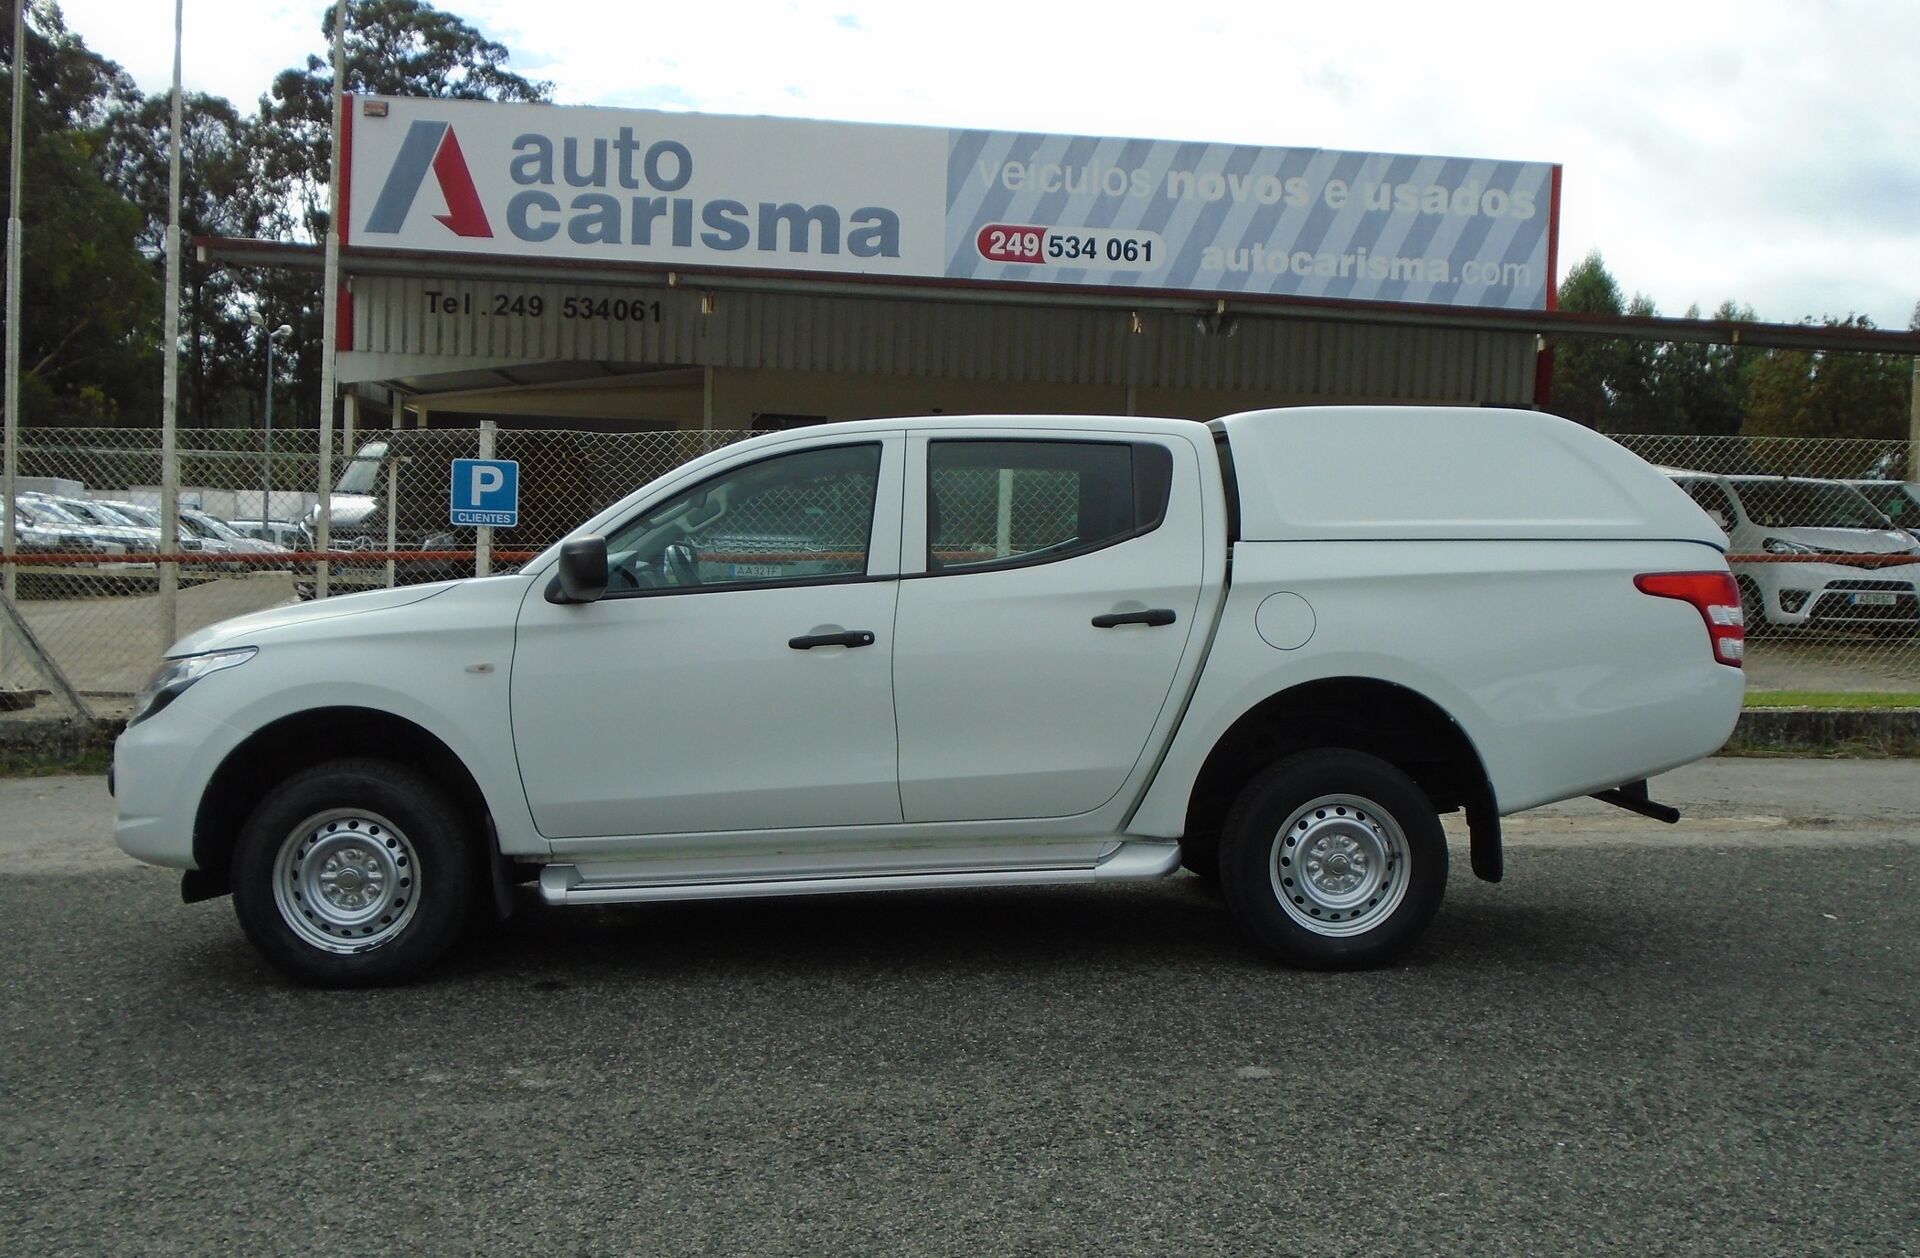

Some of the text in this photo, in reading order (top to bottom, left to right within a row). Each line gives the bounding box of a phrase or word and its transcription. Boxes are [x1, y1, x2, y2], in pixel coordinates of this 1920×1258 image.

[509, 126, 693, 192] auto
[977, 153, 1536, 220] veículos novos e usados
[506, 189, 901, 258] carisma
[989, 230, 1152, 262] 249 534 061
[1201, 243, 1532, 287] autocarisma.com
[563, 297, 661, 322] 534061
[471, 465, 504, 506] P
[458, 512, 511, 524] CLIENTES
